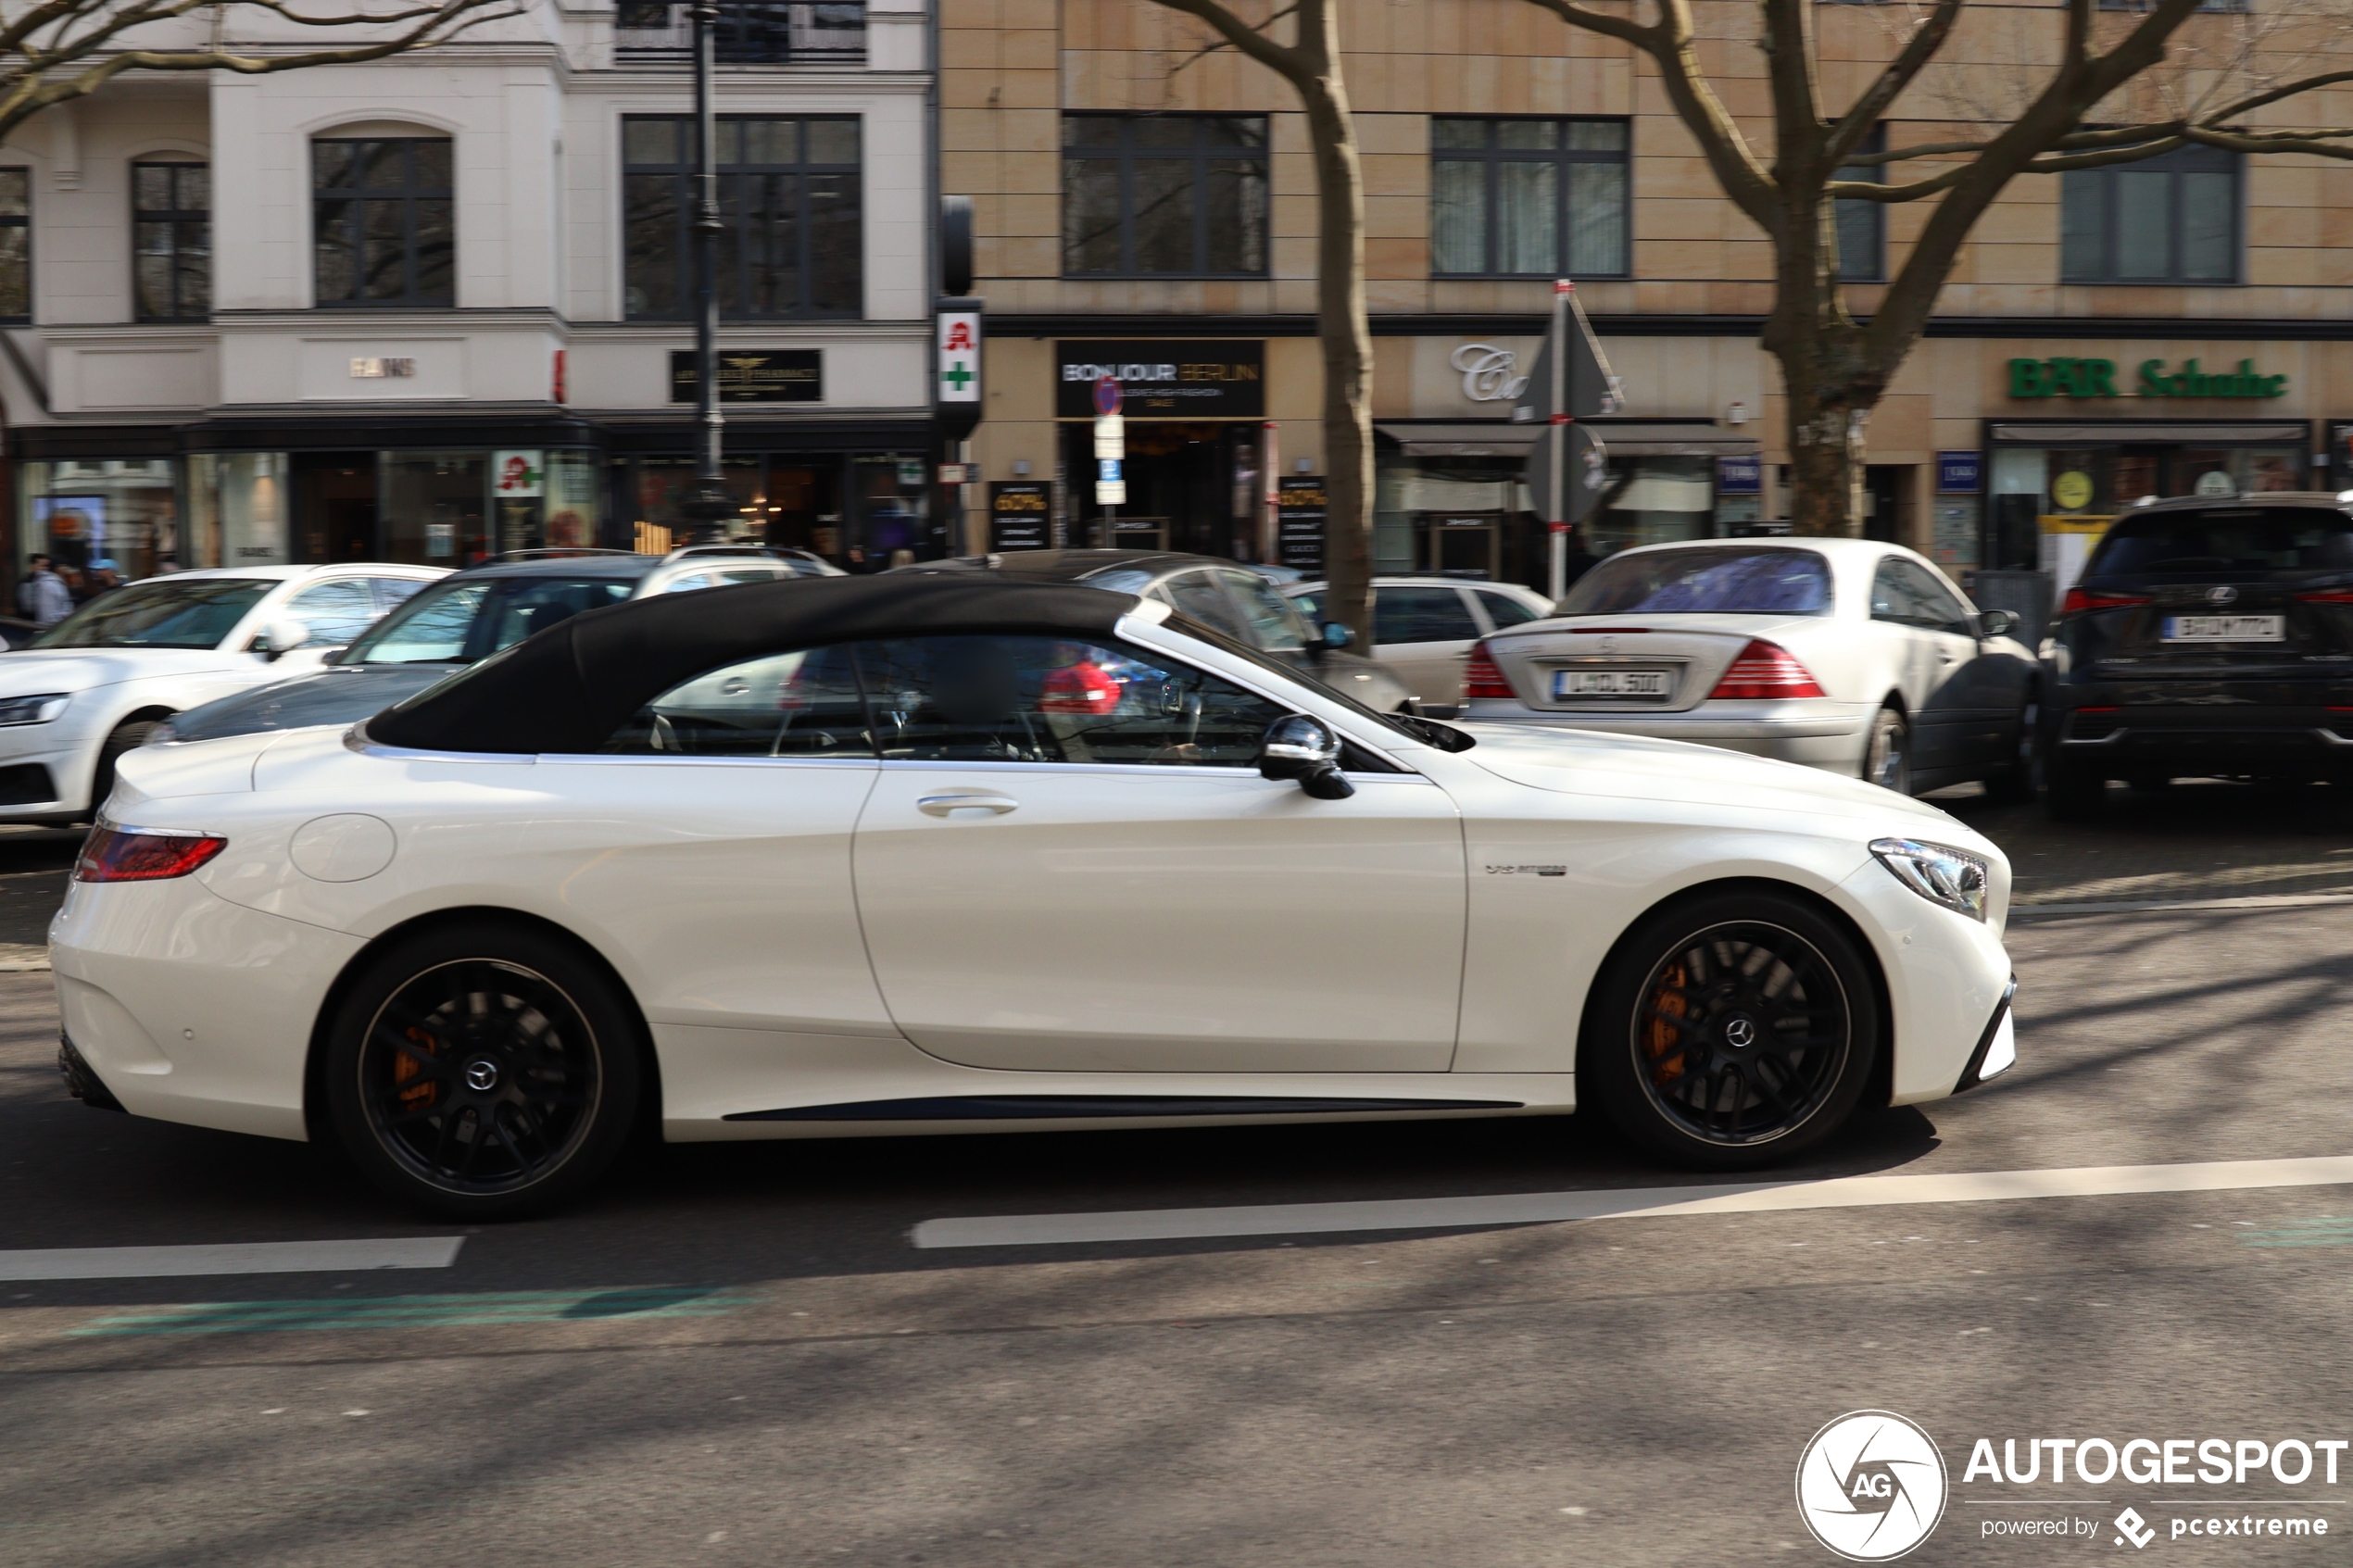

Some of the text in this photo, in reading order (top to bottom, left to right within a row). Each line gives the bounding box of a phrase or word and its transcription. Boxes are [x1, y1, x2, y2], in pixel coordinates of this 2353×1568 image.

[1062, 363, 1259, 382] BONJOUR BERLIN
[2008, 356, 2290, 399] BÄR Schuhe
